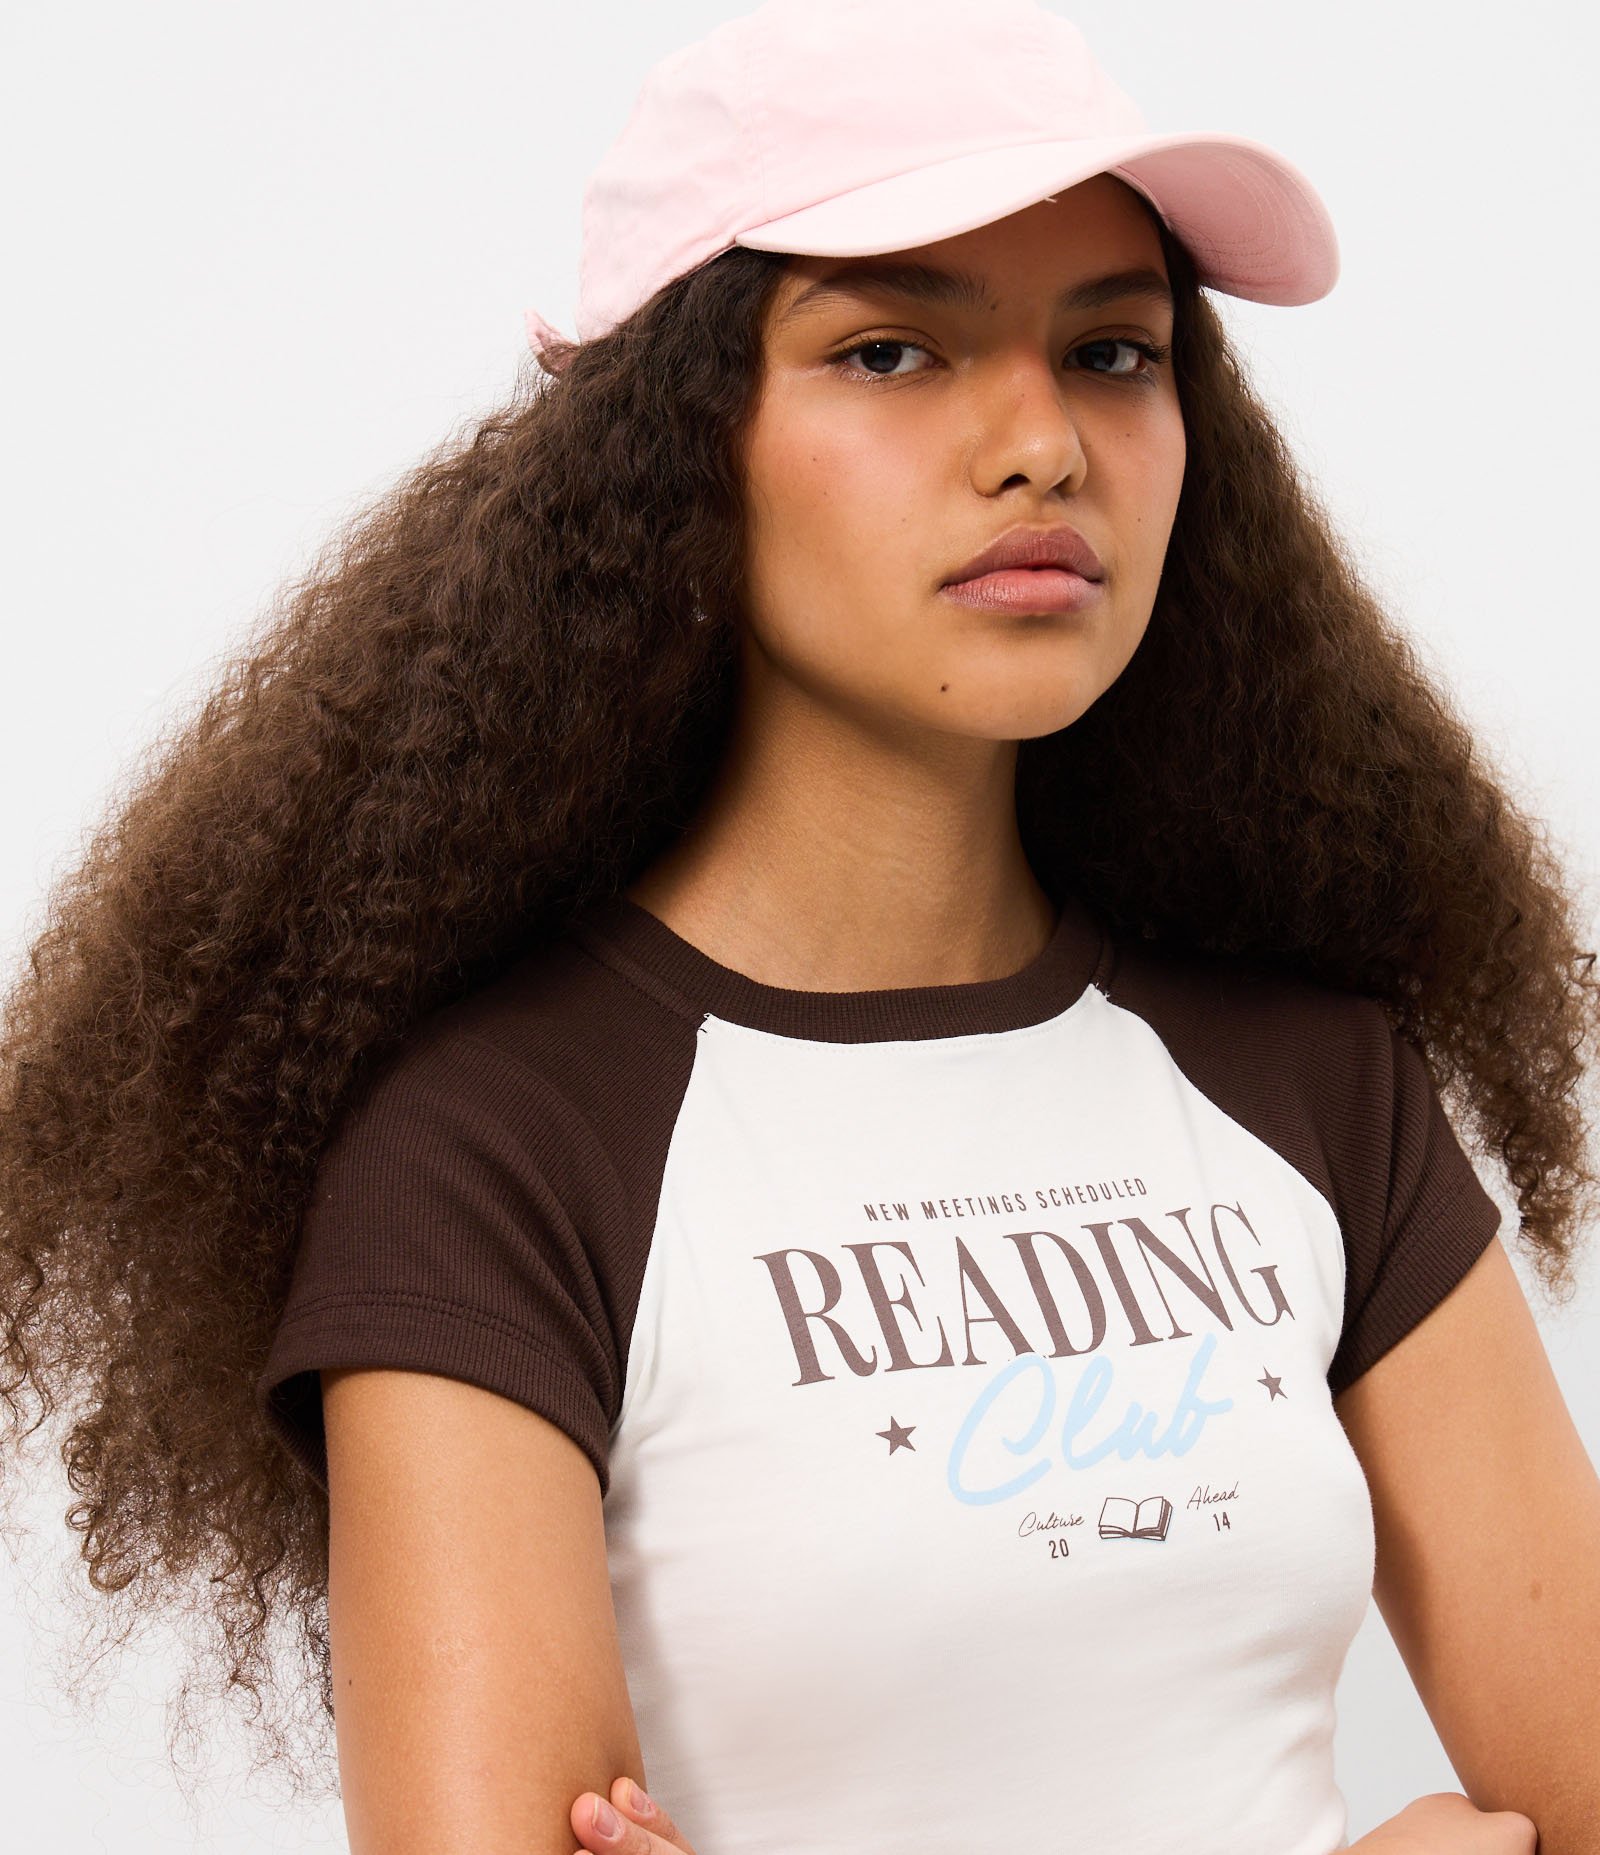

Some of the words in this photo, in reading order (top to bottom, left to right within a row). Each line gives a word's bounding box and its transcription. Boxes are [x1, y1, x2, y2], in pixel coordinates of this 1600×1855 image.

[863, 1201, 910, 1222] NEW
[921, 1192, 1028, 1219] MEETINGS
[1035, 1177, 1149, 1210] SCHEDULED
[752, 1201, 1296, 1387] READING
[946, 1332, 1234, 1507] Club
[1018, 1511, 1085, 1537] Culture
[1186, 1481, 1240, 1510] Ahead
[1048, 1538, 1070, 1559] 20
[1212, 1511, 1231, 1532] 14
